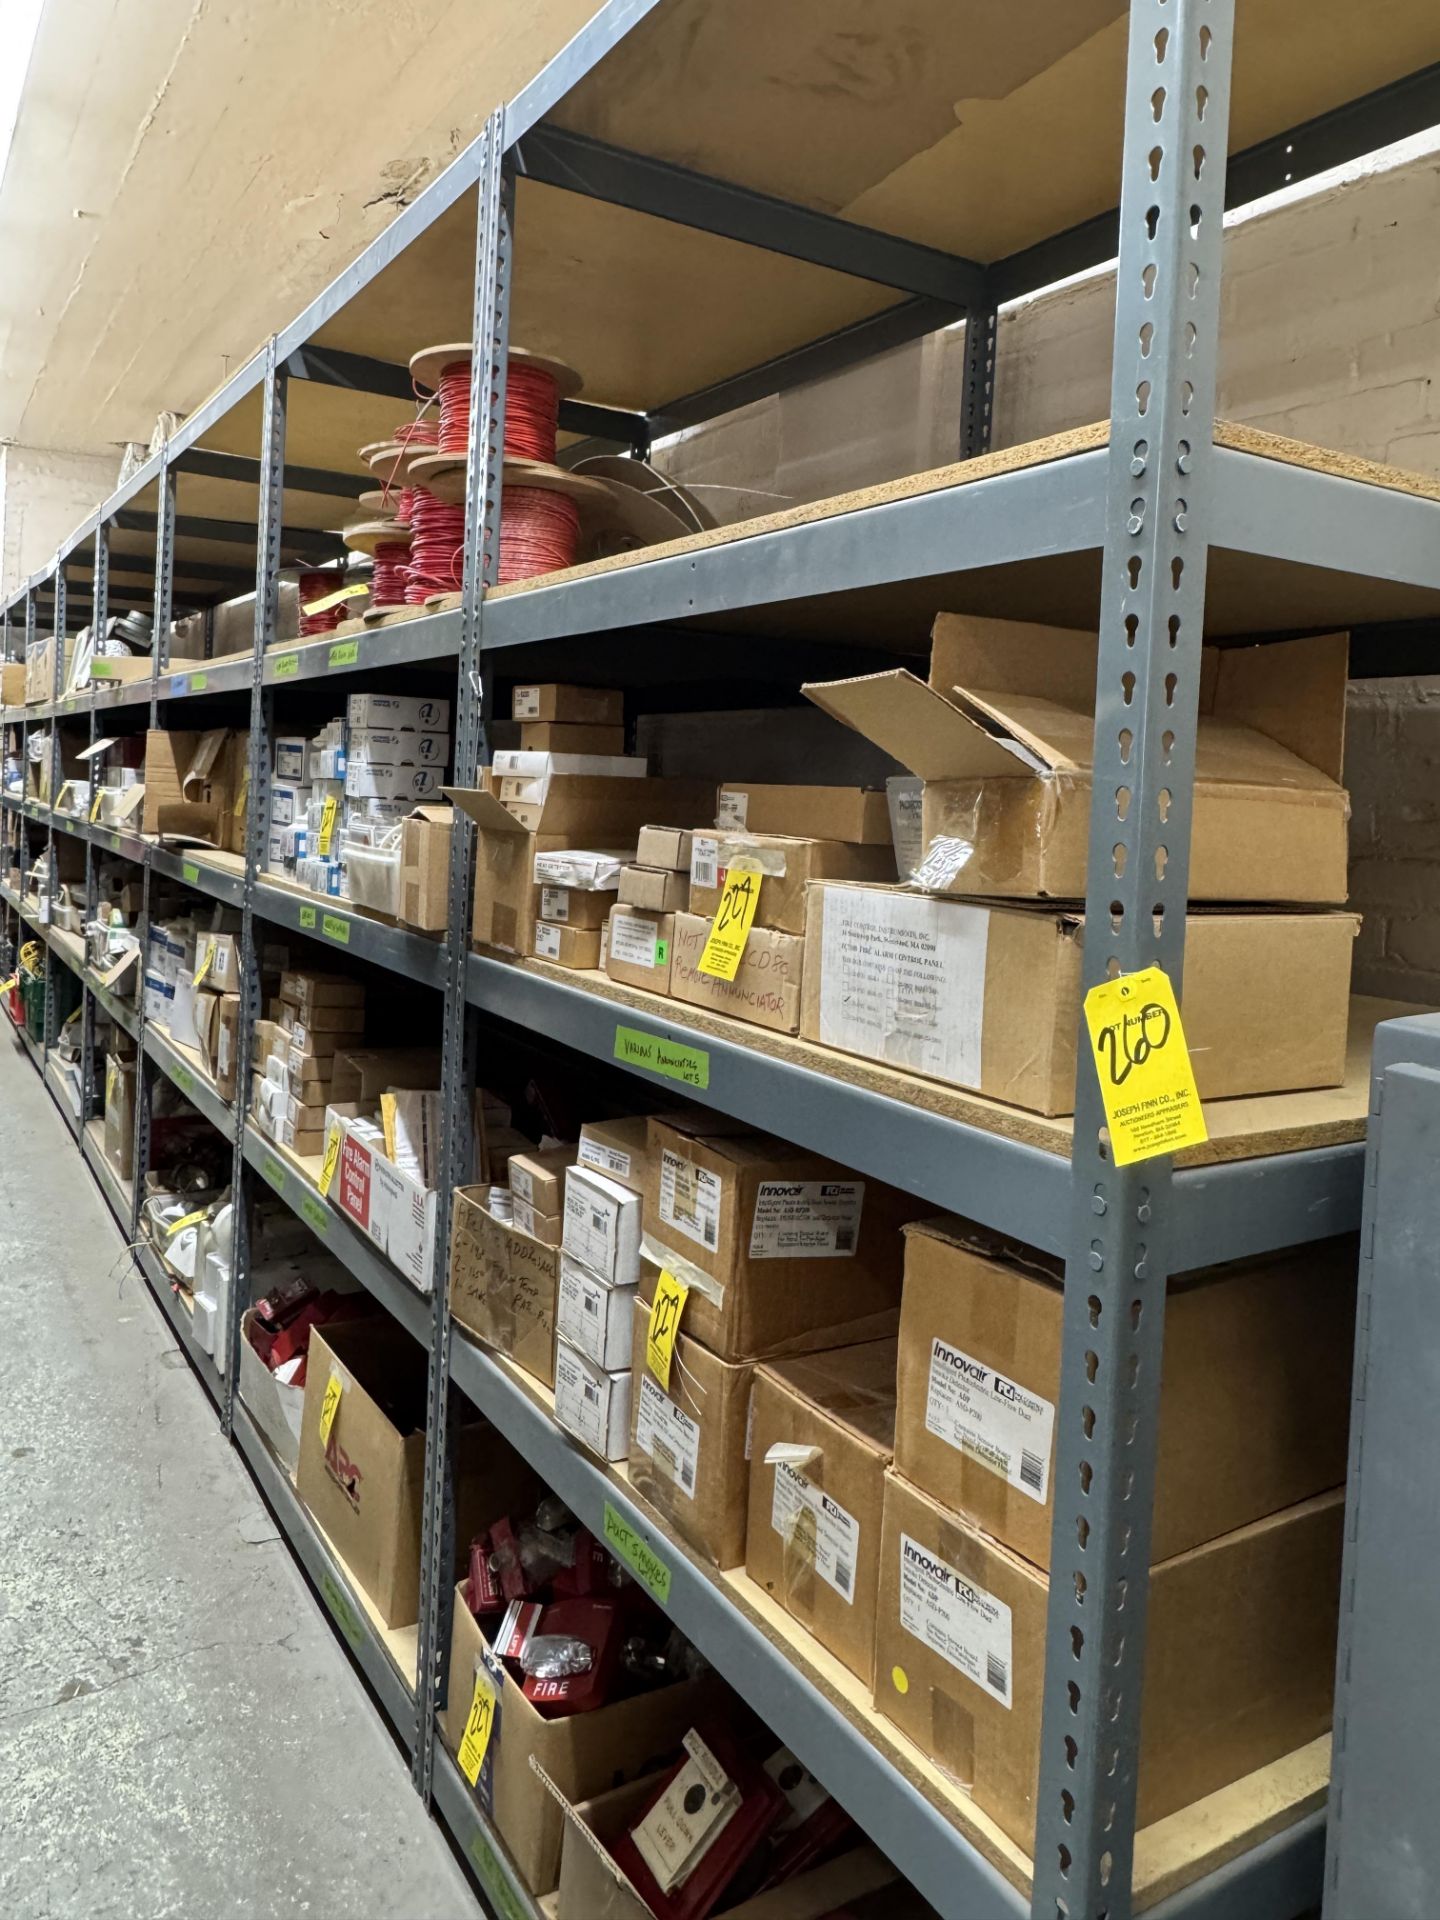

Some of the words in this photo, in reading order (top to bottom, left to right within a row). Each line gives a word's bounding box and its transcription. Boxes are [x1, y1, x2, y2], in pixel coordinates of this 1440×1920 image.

[1098, 1003, 1170, 1086] 260
[1113, 1103, 1140, 1119] JOSEPH
[1141, 1098, 1158, 1111] FINN
[760, 1184, 806, 1196] Innovair
[934, 1341, 990, 1383] Innovair
[904, 1541, 952, 1583] Innovair
[533, 1682, 570, 1696] FIRE
